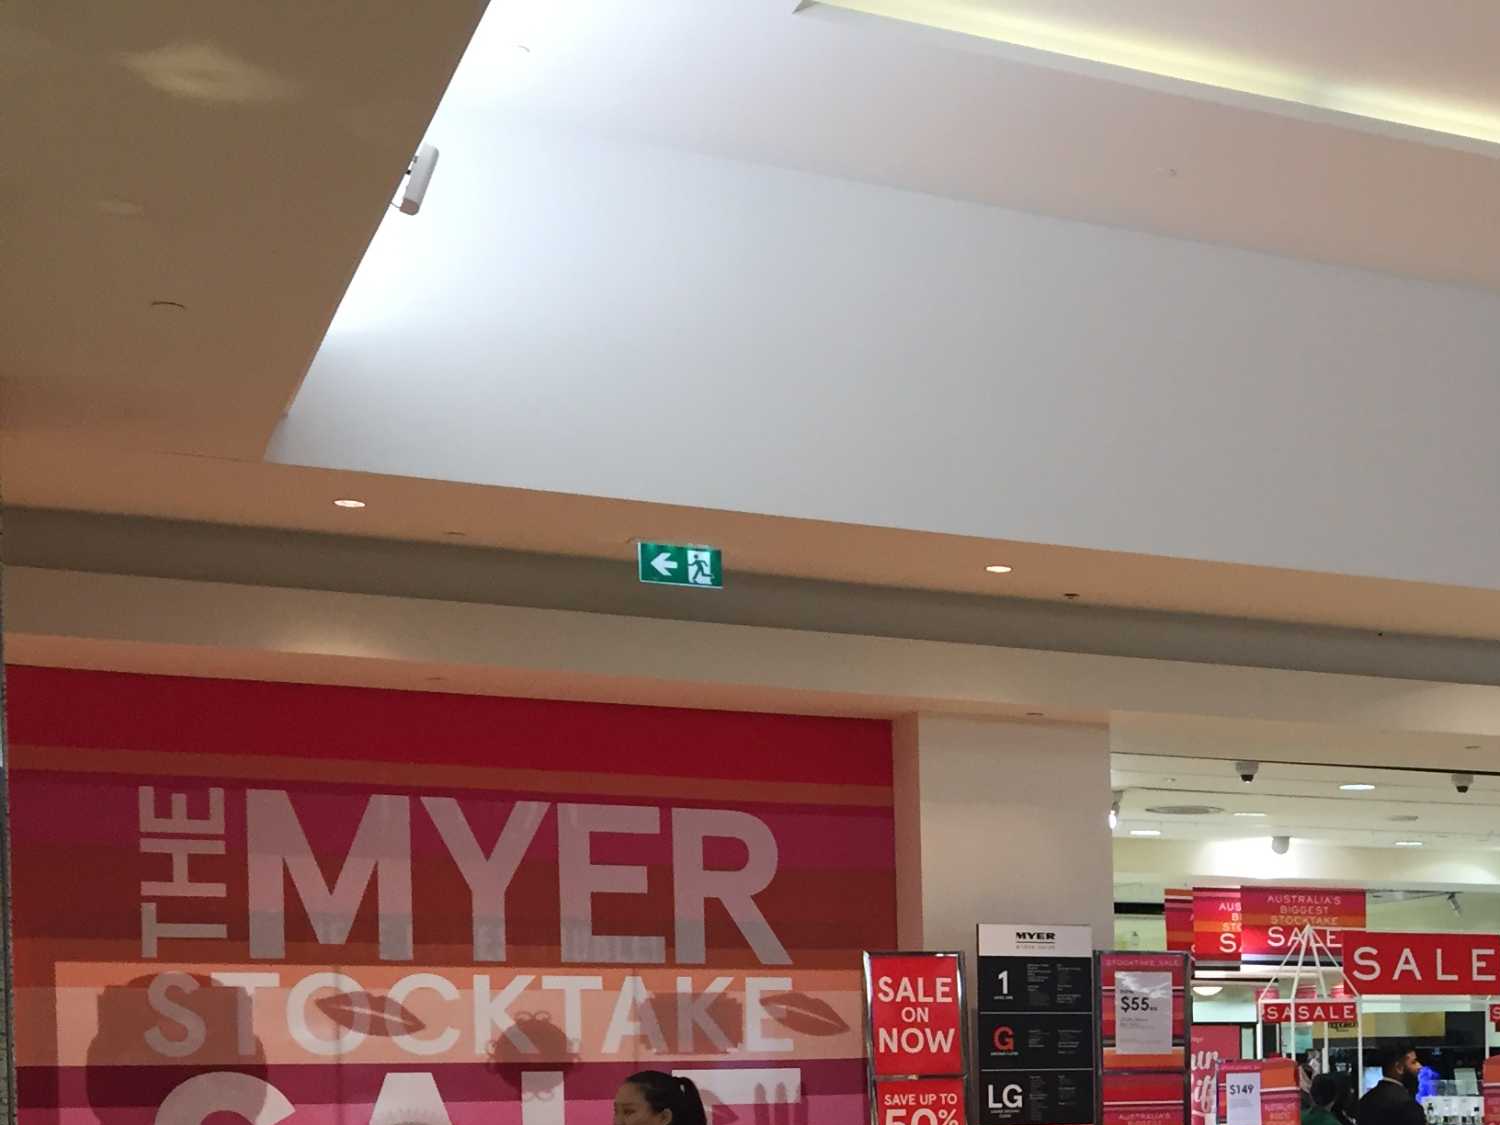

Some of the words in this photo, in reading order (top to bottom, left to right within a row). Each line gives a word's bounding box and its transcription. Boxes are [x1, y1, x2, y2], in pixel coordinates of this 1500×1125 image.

[139, 786, 228, 958] THE
[245, 788, 794, 965] MYER
[1266, 895, 1342, 905] AUSTRALIA'S
[1280, 906, 1329, 914] BIGGEST
[1015, 932, 1056, 940] MYER
[1352, 947, 1497, 982] SALE
[878, 975, 953, 1003] SALE
[998, 970, 1008, 995] 1
[143, 971, 795, 1057] STOCKTAKE
[901, 1007, 929, 1023] ON
[1121, 996, 1150, 1013] $55
[1298, 1005, 1355, 1020] SALE
[878, 1027, 955, 1054] NOW
[993, 1026, 1014, 1051] G
[884, 1093, 917, 1106] SAVE
[919, 1093, 937, 1106] UP
[940, 1093, 958, 1105] TO
[987, 1084, 1023, 1109] LG
[1229, 1084, 1254, 1095] $149
